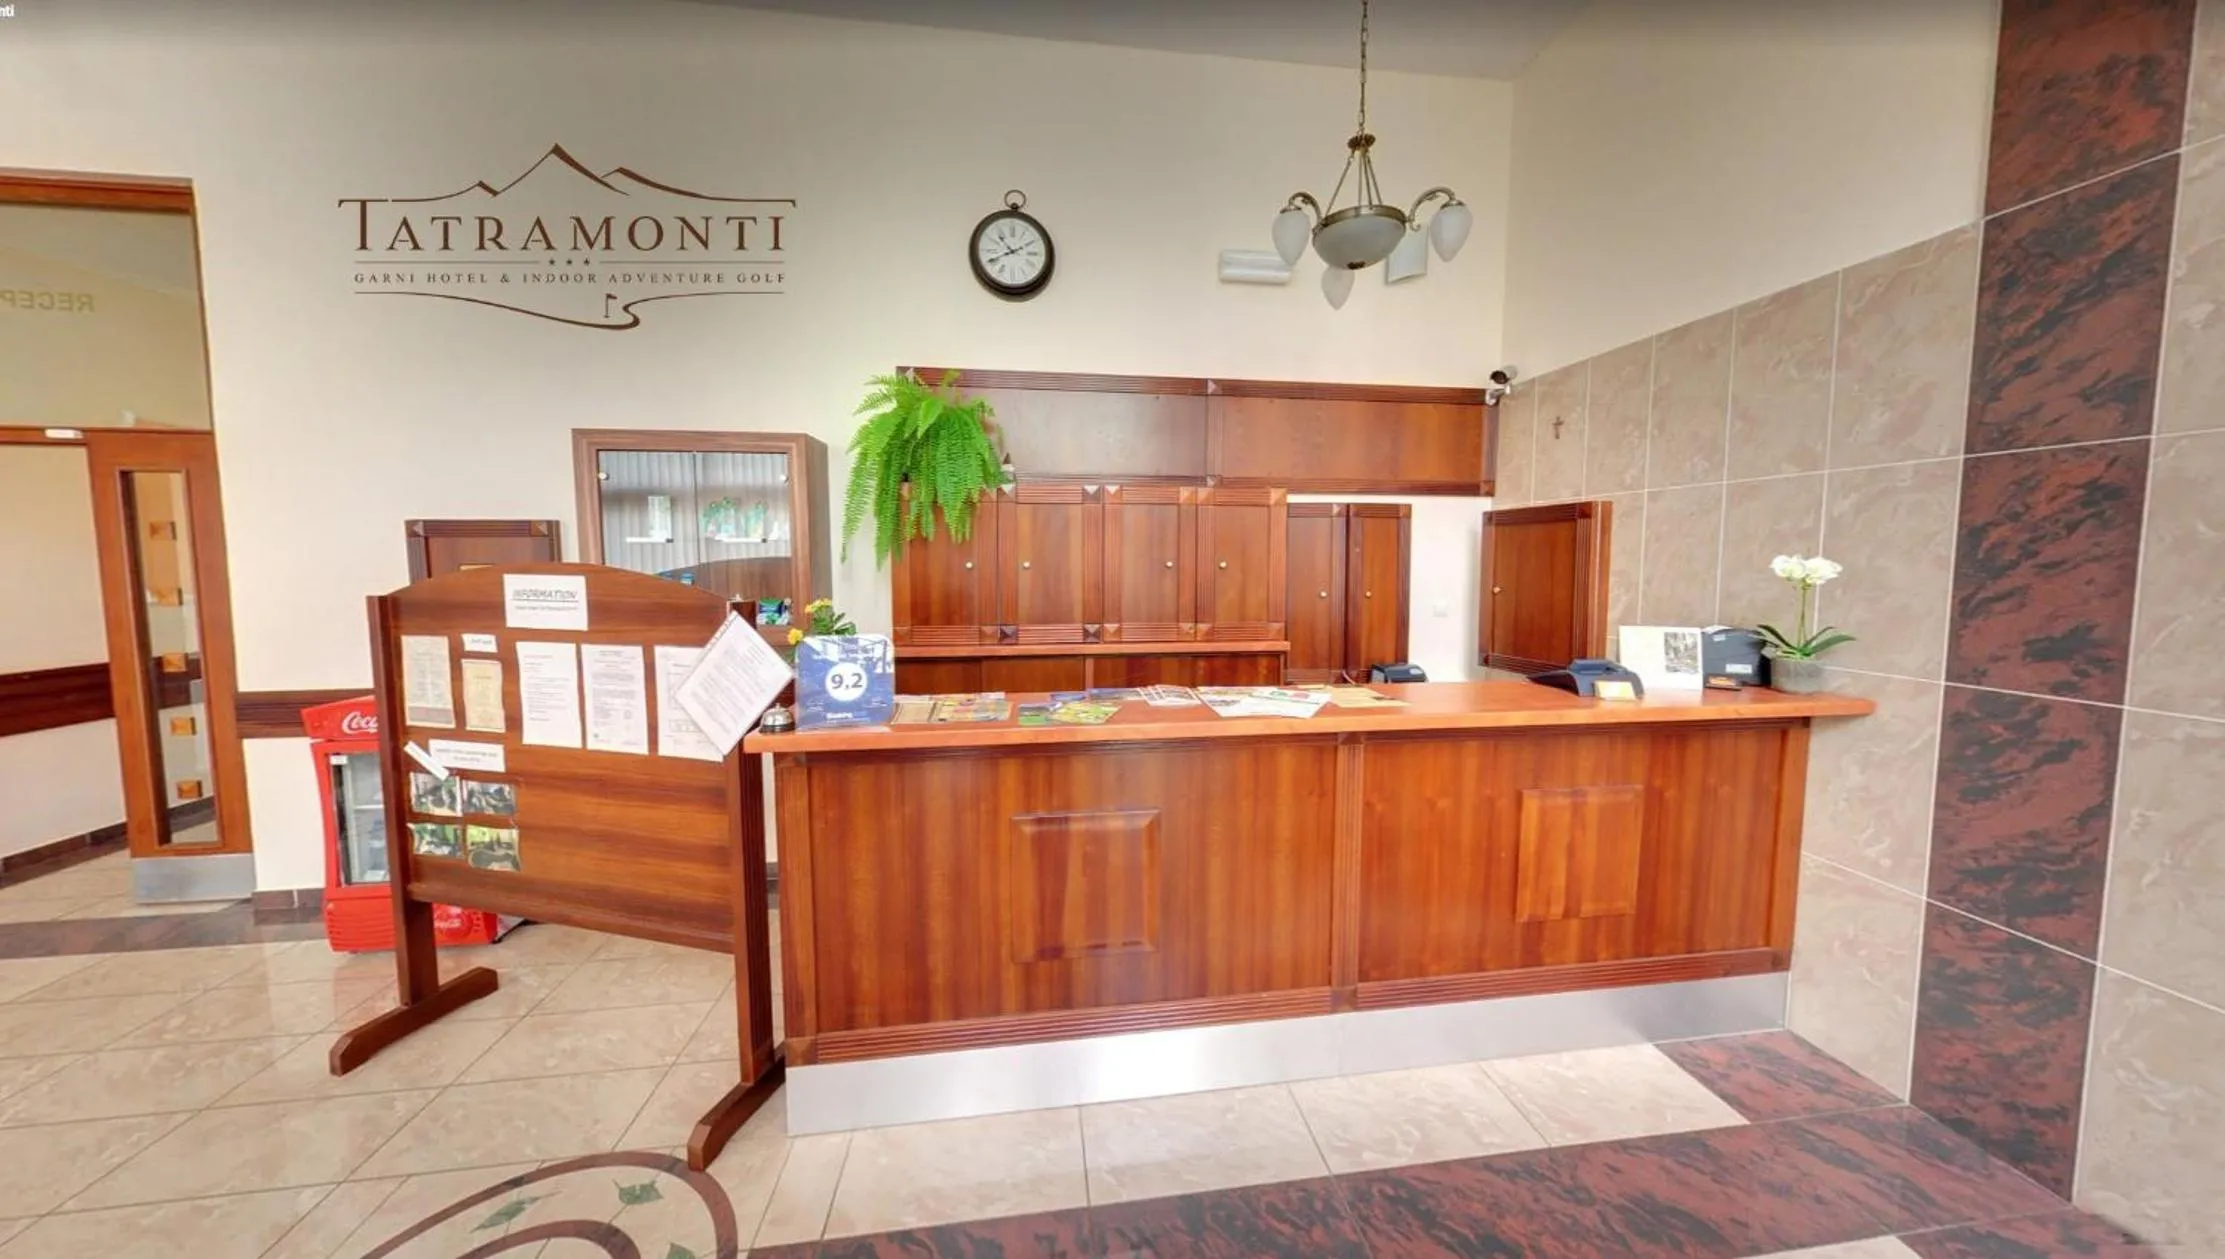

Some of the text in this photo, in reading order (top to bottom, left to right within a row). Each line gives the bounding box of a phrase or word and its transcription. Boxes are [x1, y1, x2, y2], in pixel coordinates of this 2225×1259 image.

[338, 199, 785, 251] TATRAMONTI
[354, 272, 786, 284] GARNI HOTEL & INDOOR ADVENTURE GOLF
